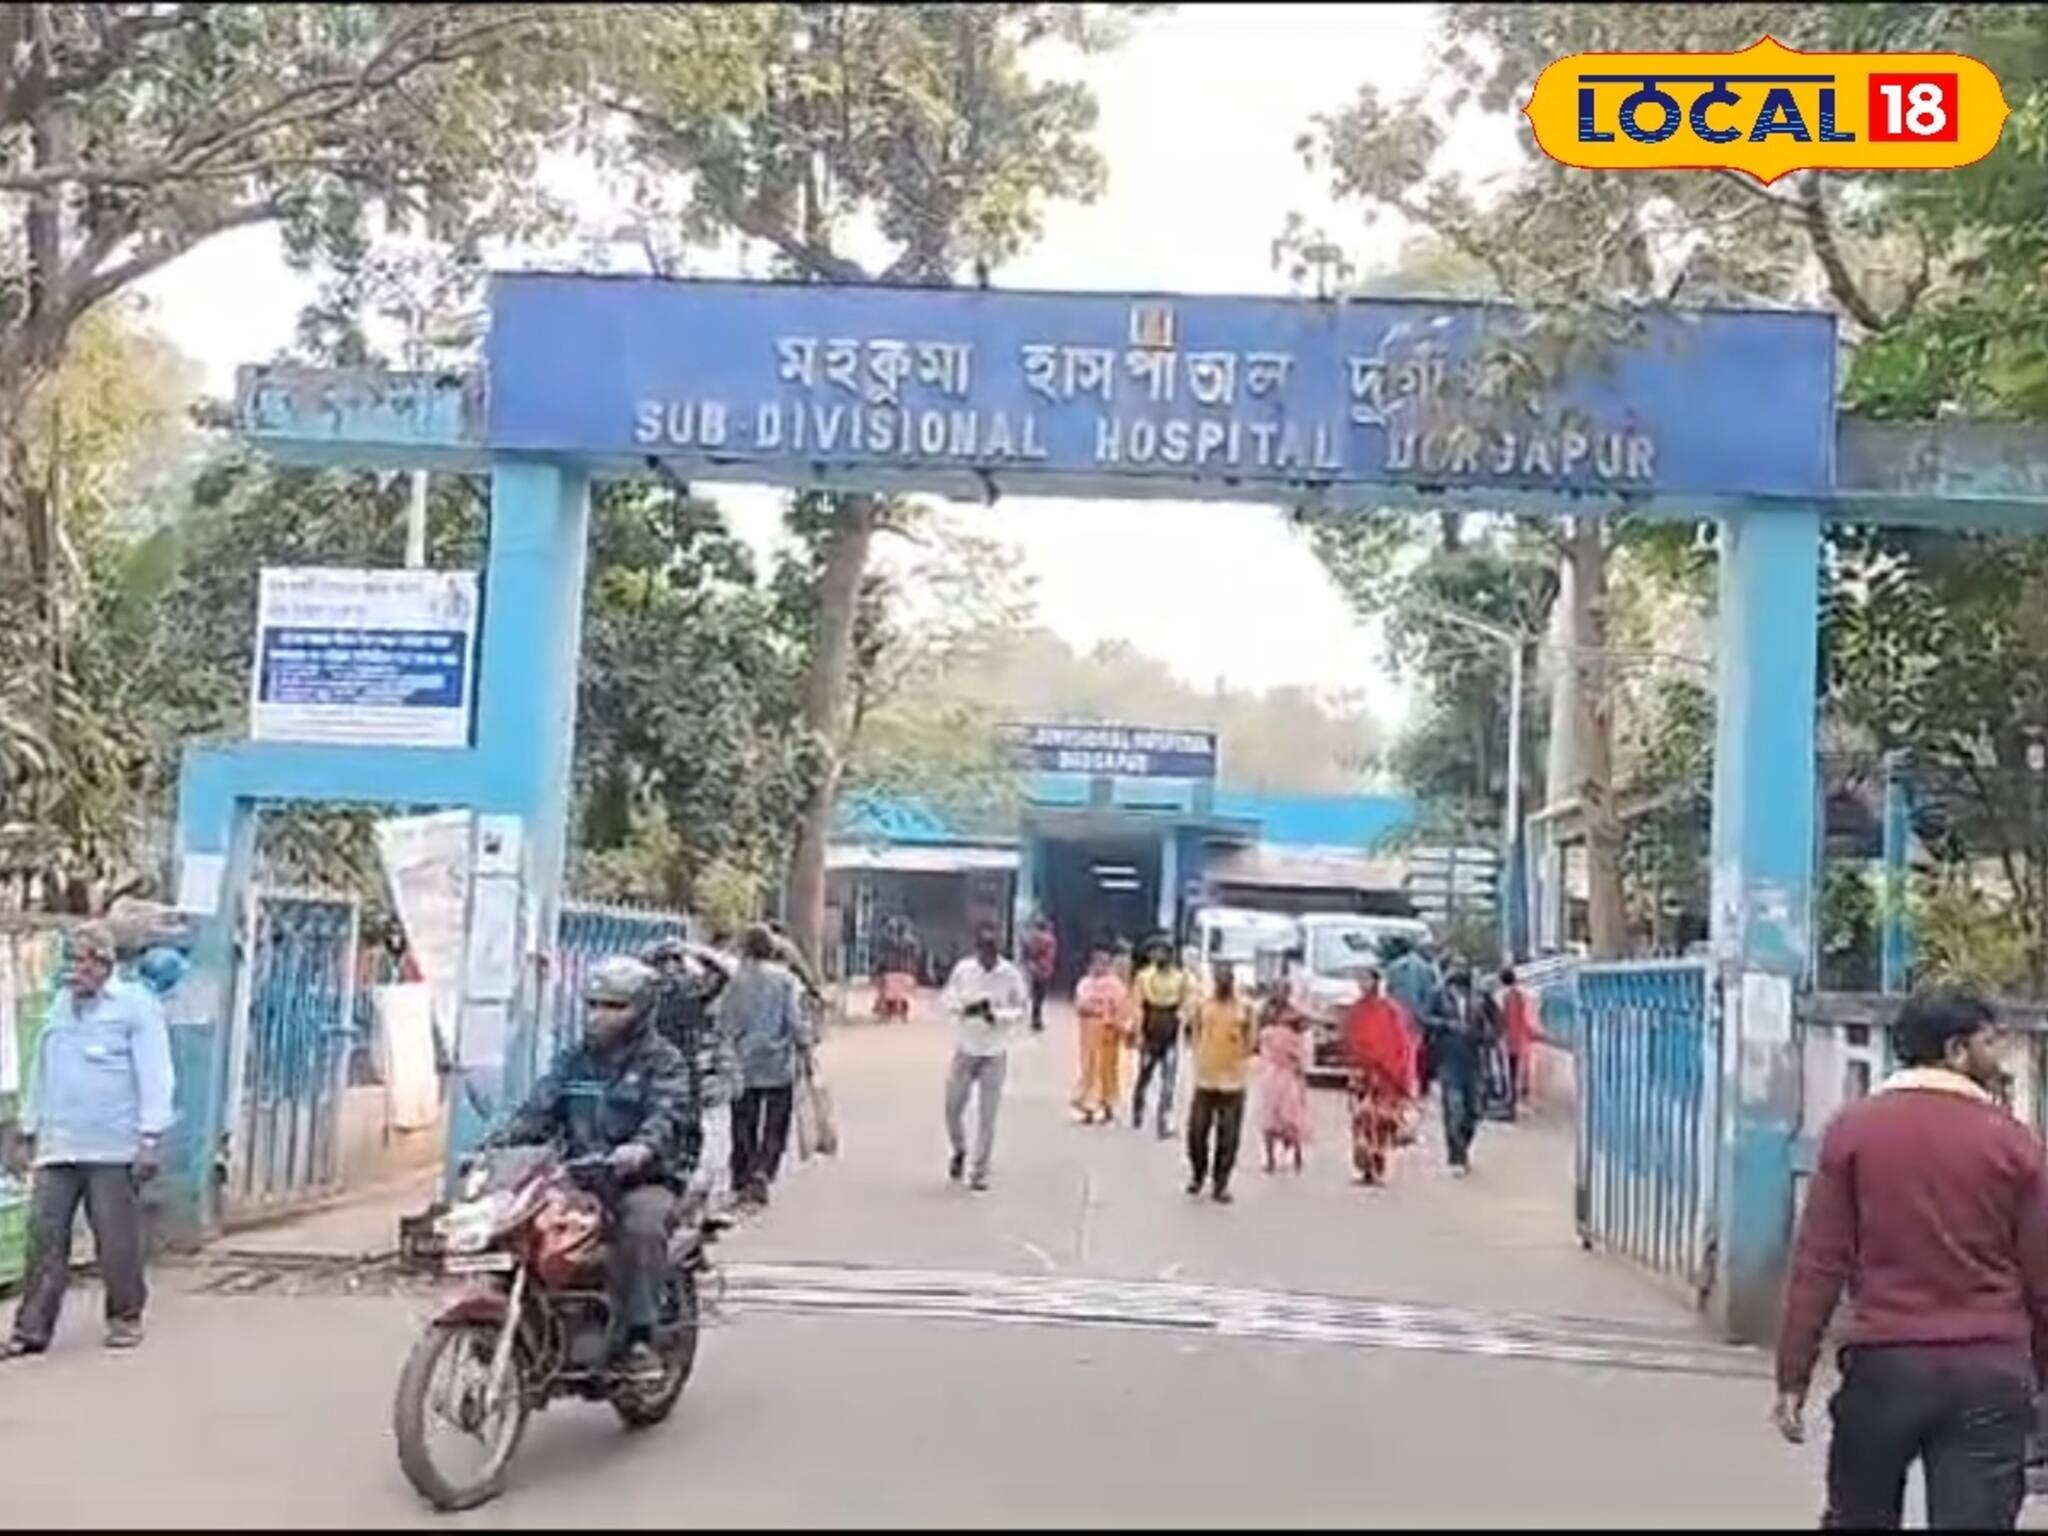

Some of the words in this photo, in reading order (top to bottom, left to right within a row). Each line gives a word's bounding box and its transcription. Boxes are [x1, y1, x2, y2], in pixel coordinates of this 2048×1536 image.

[775, 338, 974, 403] মহকুমা
[1021, 345, 1293, 402] হাসপাতাল
[1095, 417, 1343, 468] HOSPITAL
